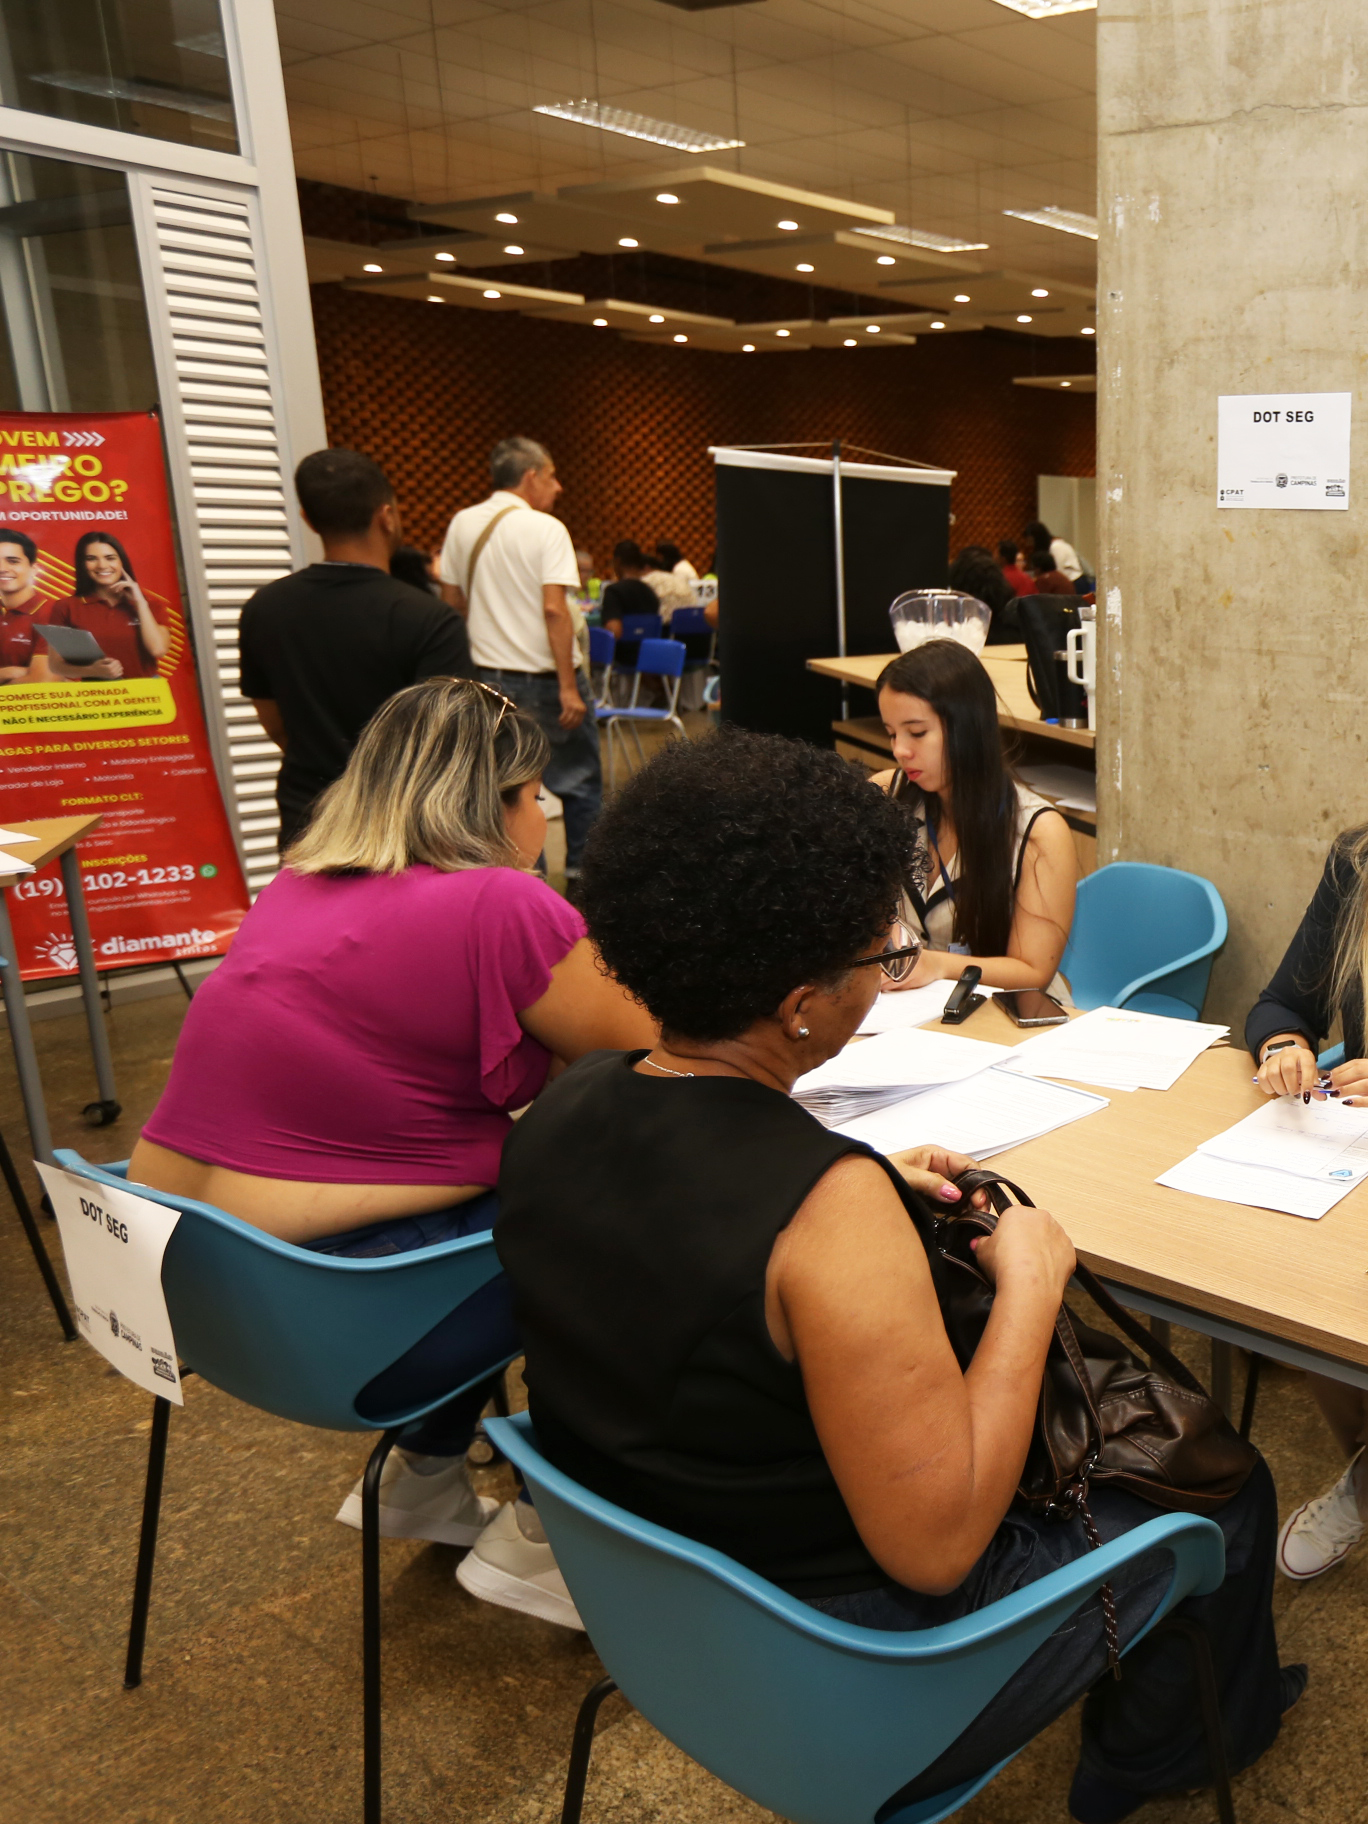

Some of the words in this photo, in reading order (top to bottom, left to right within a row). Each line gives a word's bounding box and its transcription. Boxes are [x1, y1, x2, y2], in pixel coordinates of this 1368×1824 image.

[1253, 411, 1281, 423] DOT
[1285, 411, 1314, 422] SEG
[0, 430, 60, 446] VEM
[9, 510, 128, 520] OPORTUNIDADE!
[0, 692, 47, 702] COMECE
[49, 691, 72, 699] SUA
[76, 688, 129, 697] JORNADA
[0, 701, 81, 712] PROFISSIONAL
[84, 699, 111, 708] COM
[124, 696, 160, 704] GENTE!
[3, 716, 26, 725] NÃO
[36, 712, 100, 723] NECESSÁRIO
[102, 708, 163, 719] EXPERIÊNCIA
[36, 743, 72, 754] PARA
[73, 739, 136, 752] DIVERSOS
[138, 734, 190, 746] SETORES
[61, 794, 119, 806] FORMATO
[82, 853, 148, 868] INSCRIÇÕES
[14, 876, 63, 901] (19)
[82, 864, 196, 891] 102-1233
[101, 928, 217, 955] diamante
[79, 1197, 103, 1226] DOT
[106, 1213, 128, 1243] SEG
